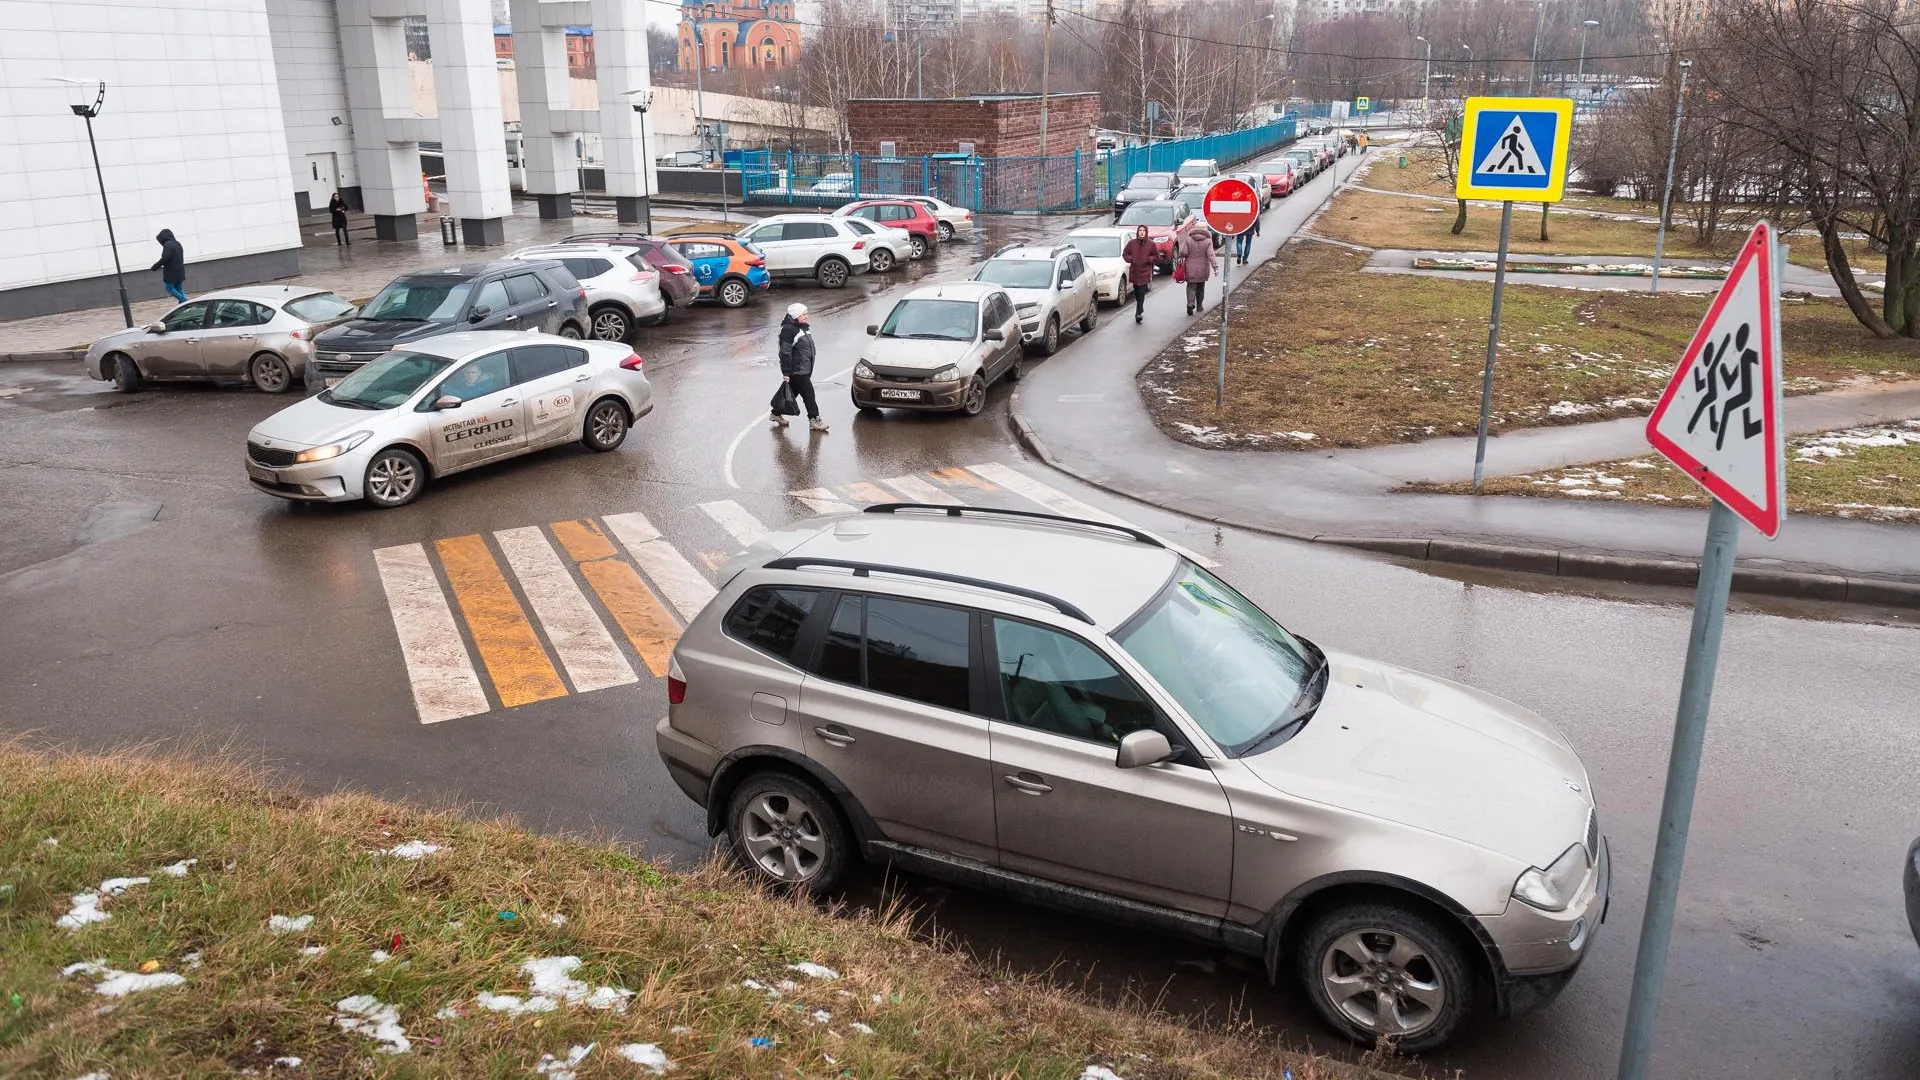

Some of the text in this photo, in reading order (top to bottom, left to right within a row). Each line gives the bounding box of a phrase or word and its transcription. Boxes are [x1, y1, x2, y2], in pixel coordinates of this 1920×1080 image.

[557, 397, 568, 406] KIA
[443, 415, 489, 432] ИСПЫТАЙ KIA
[445, 418, 514, 443] CERATO
[473, 433, 514, 449] CLASSIC
